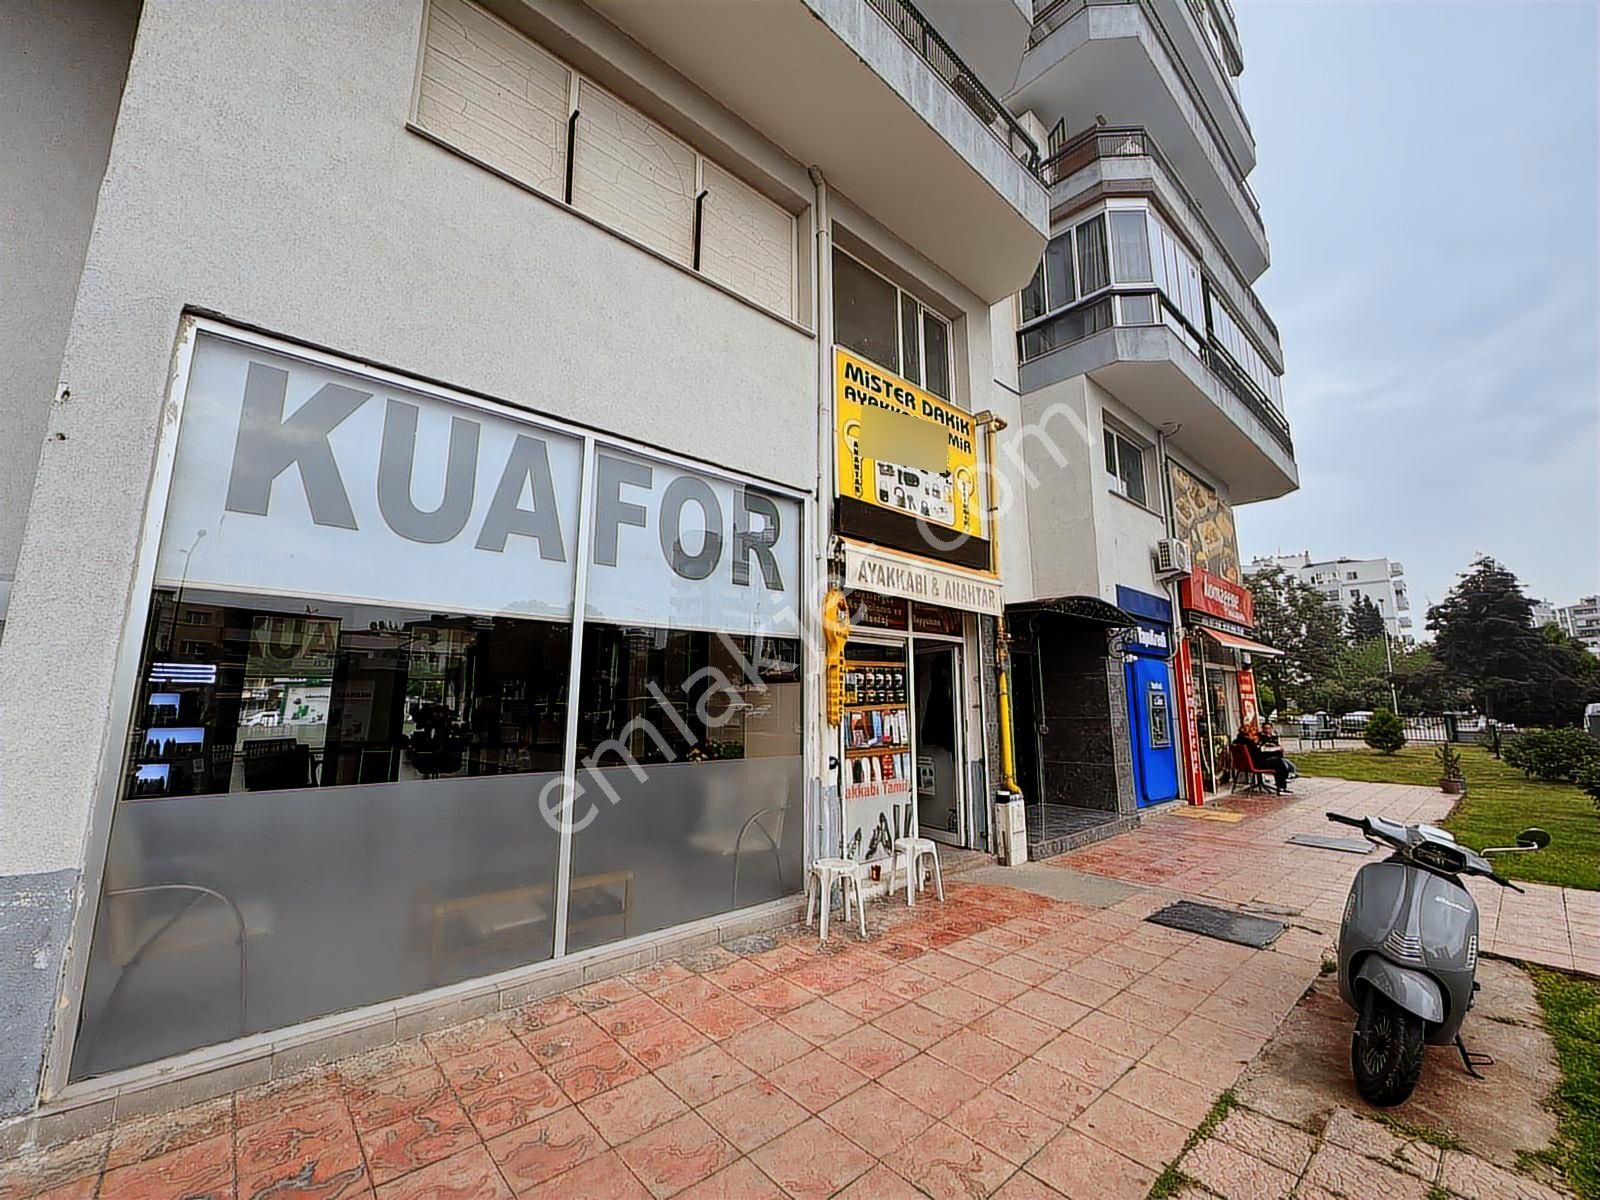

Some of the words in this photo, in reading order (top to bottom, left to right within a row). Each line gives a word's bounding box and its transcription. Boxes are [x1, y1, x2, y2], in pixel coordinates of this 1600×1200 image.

[225, 361, 784, 591] KUAFOR
[858, 560, 928, 597] AYAKKABI
[931, 577, 941, 598] &
[944, 579, 997, 609] ANAHTAR
